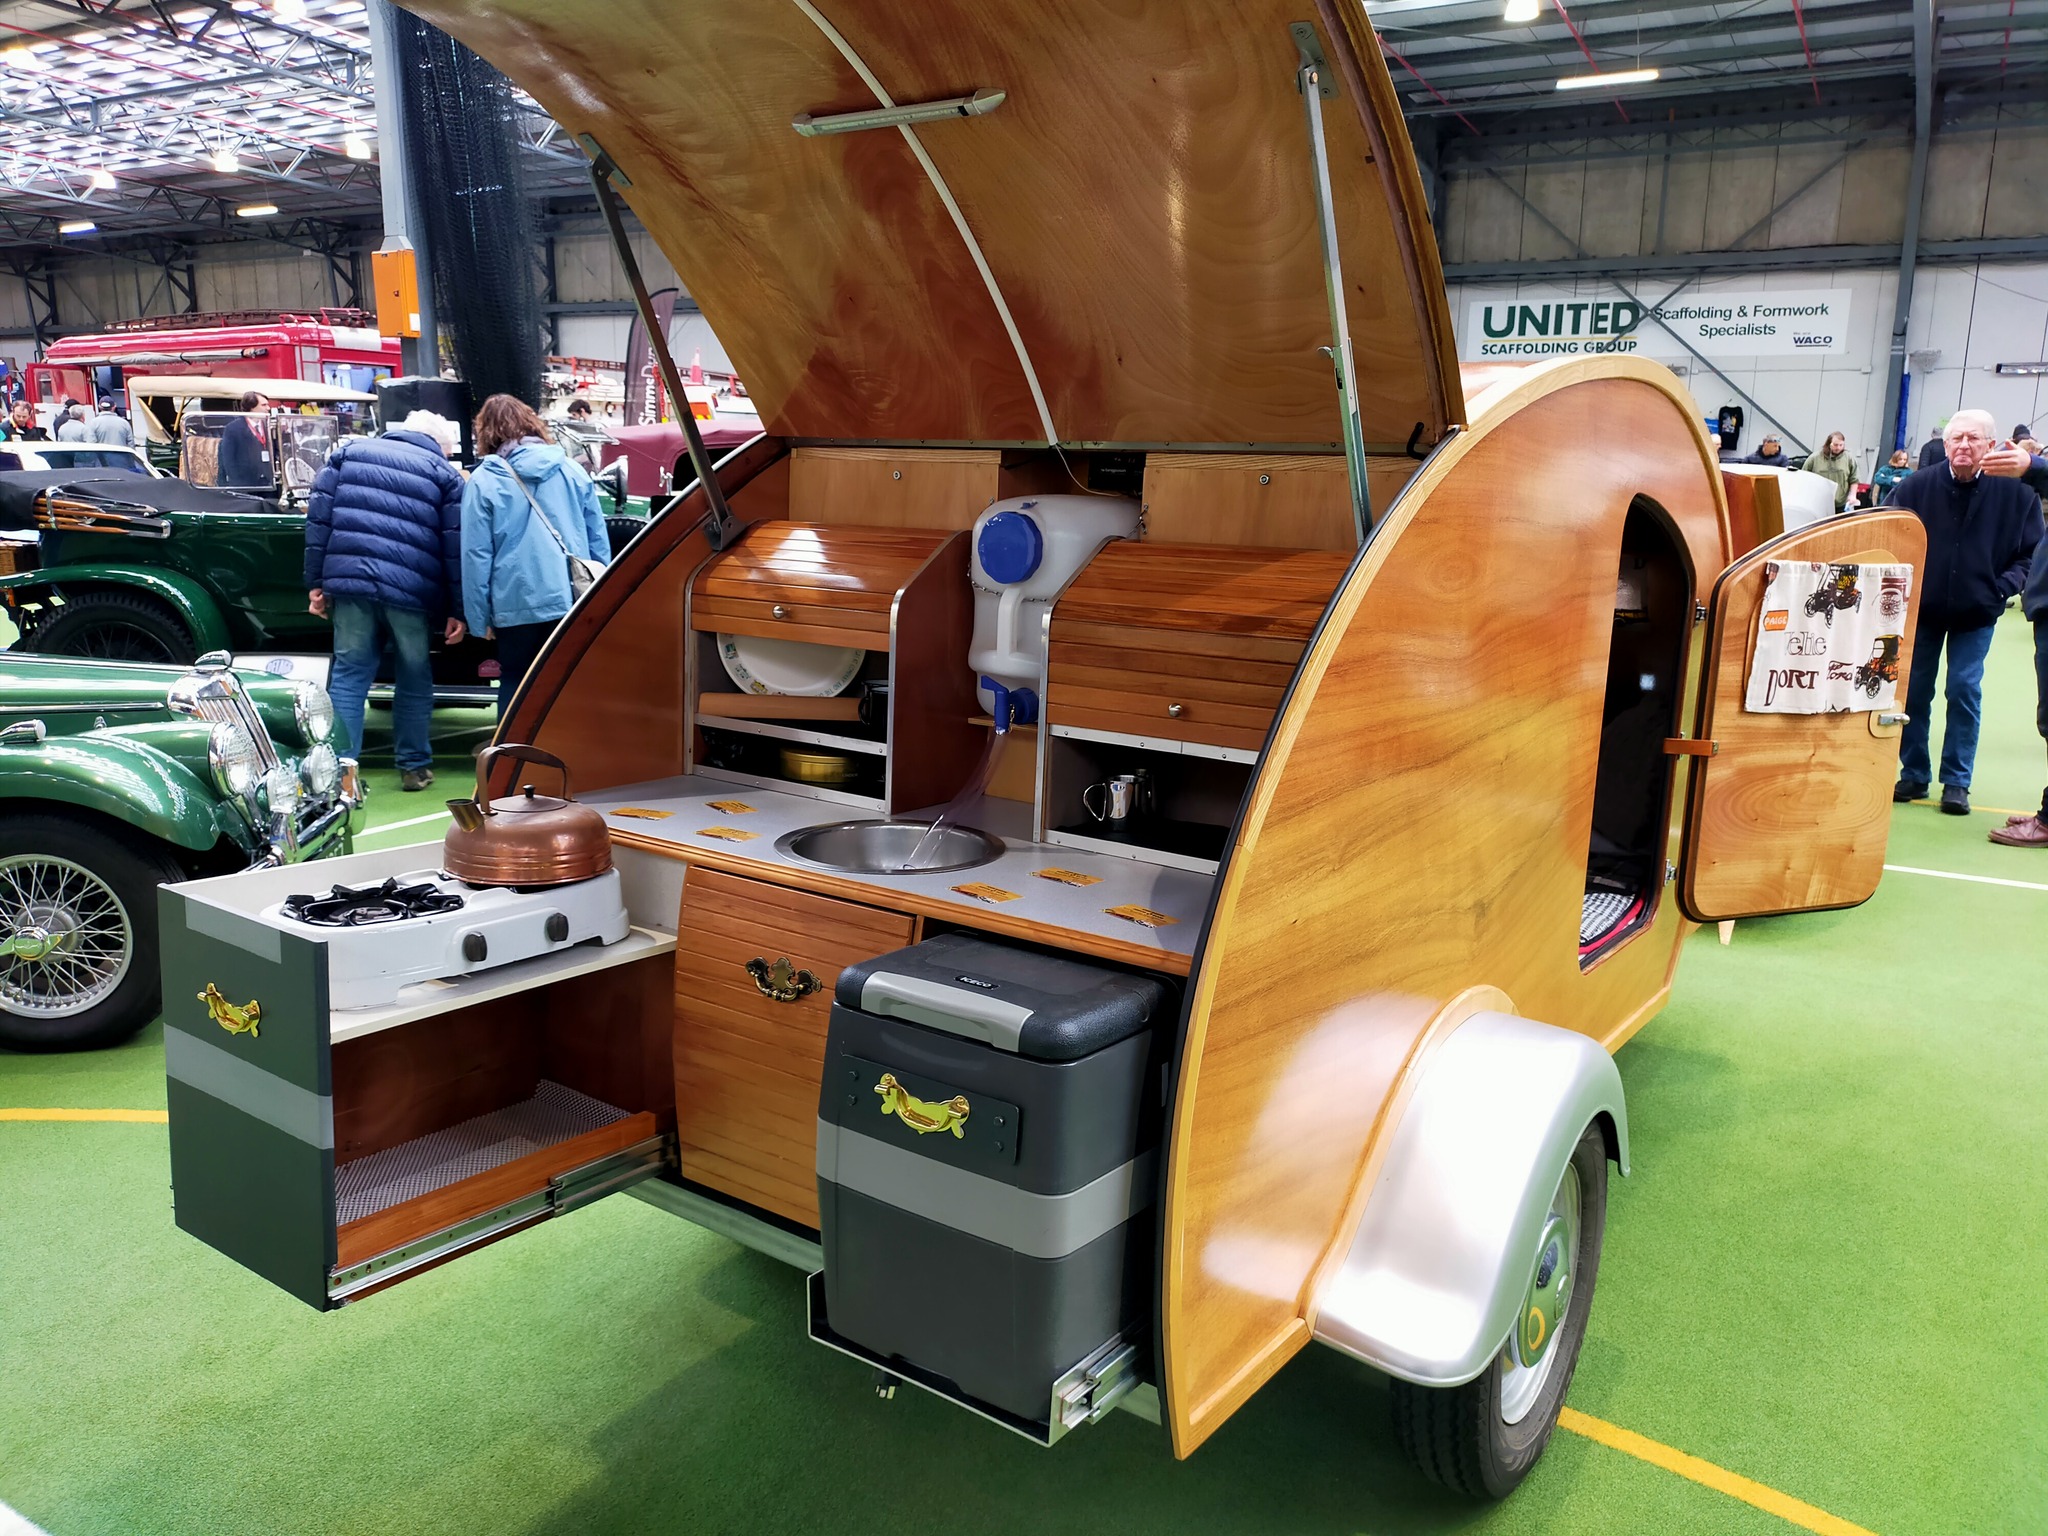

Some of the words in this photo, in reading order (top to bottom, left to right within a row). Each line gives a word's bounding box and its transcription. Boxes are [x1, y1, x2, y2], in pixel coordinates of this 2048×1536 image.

[1654, 306, 1732, 321] Scaffolding
[1737, 305, 1748, 317] &
[1753, 303, 1829, 317] Formwork
[1483, 302, 1640, 338] UNITED
[1699, 323, 1776, 339] Specialists
[1793, 336, 1833, 344] WACO
[1481, 341, 1578, 355] SCAFFOLDING
[1764, 616, 1787, 626] PAIGE
